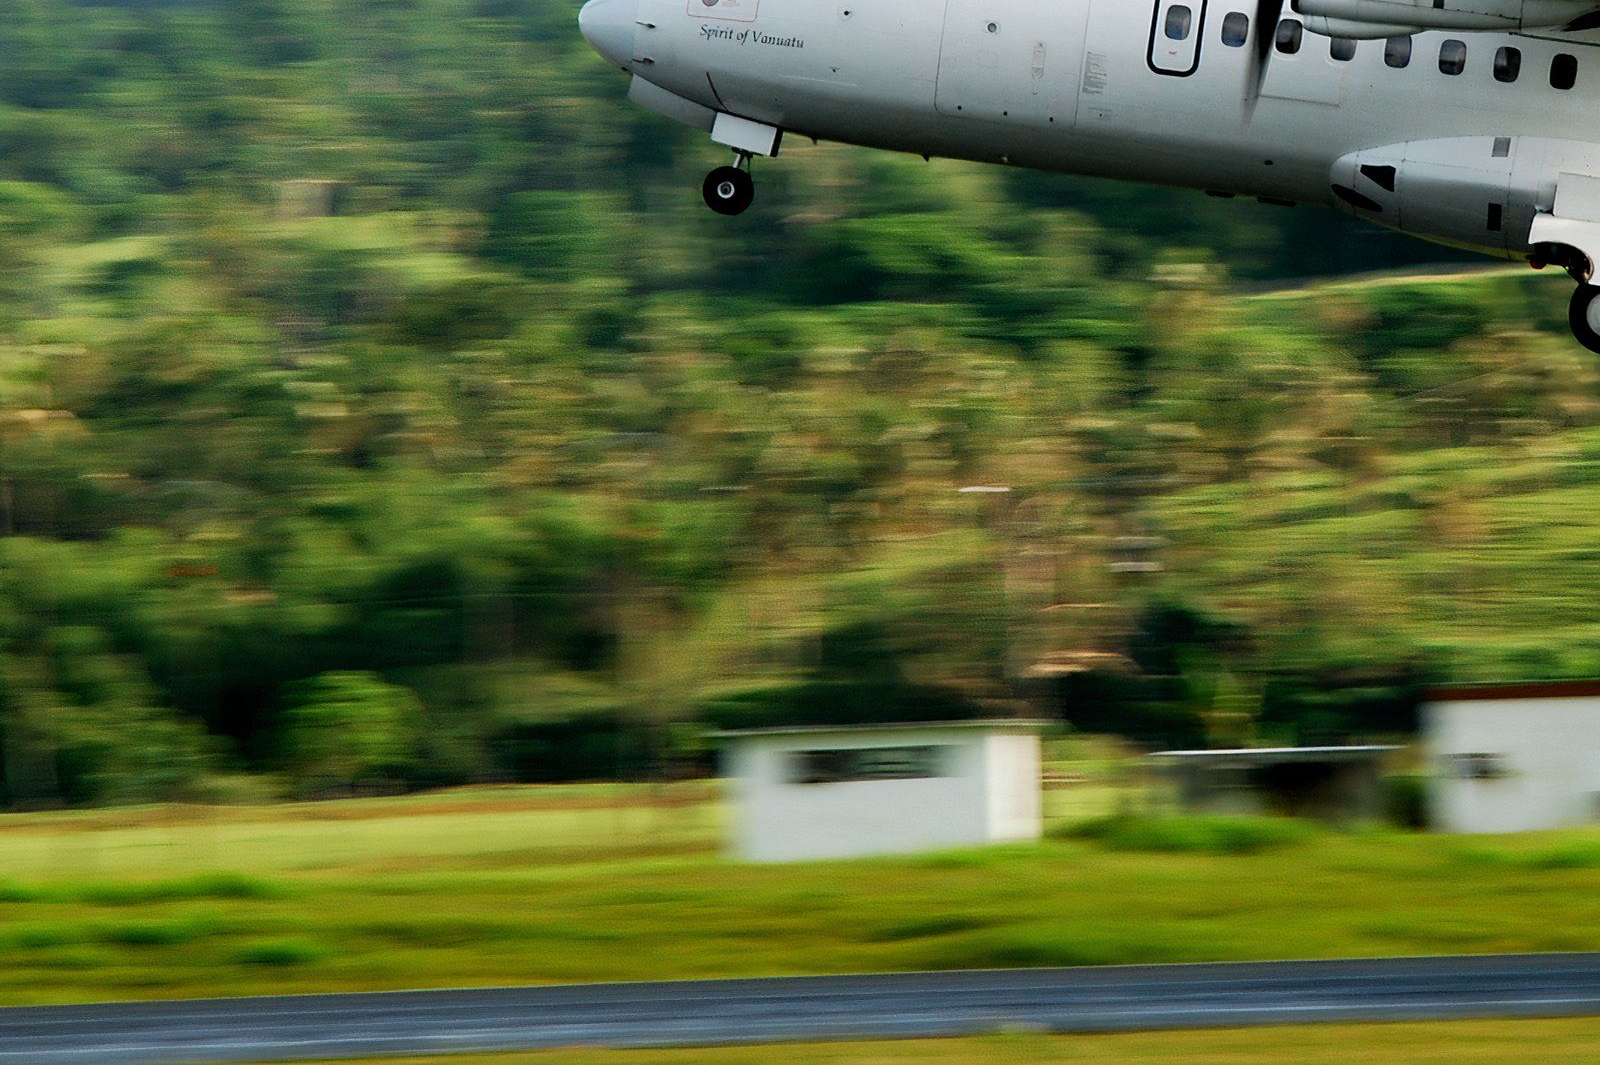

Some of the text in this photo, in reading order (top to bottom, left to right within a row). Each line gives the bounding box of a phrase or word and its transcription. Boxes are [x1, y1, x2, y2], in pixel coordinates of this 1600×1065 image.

[699, 23, 804, 48] Spirit of Vanuatu
